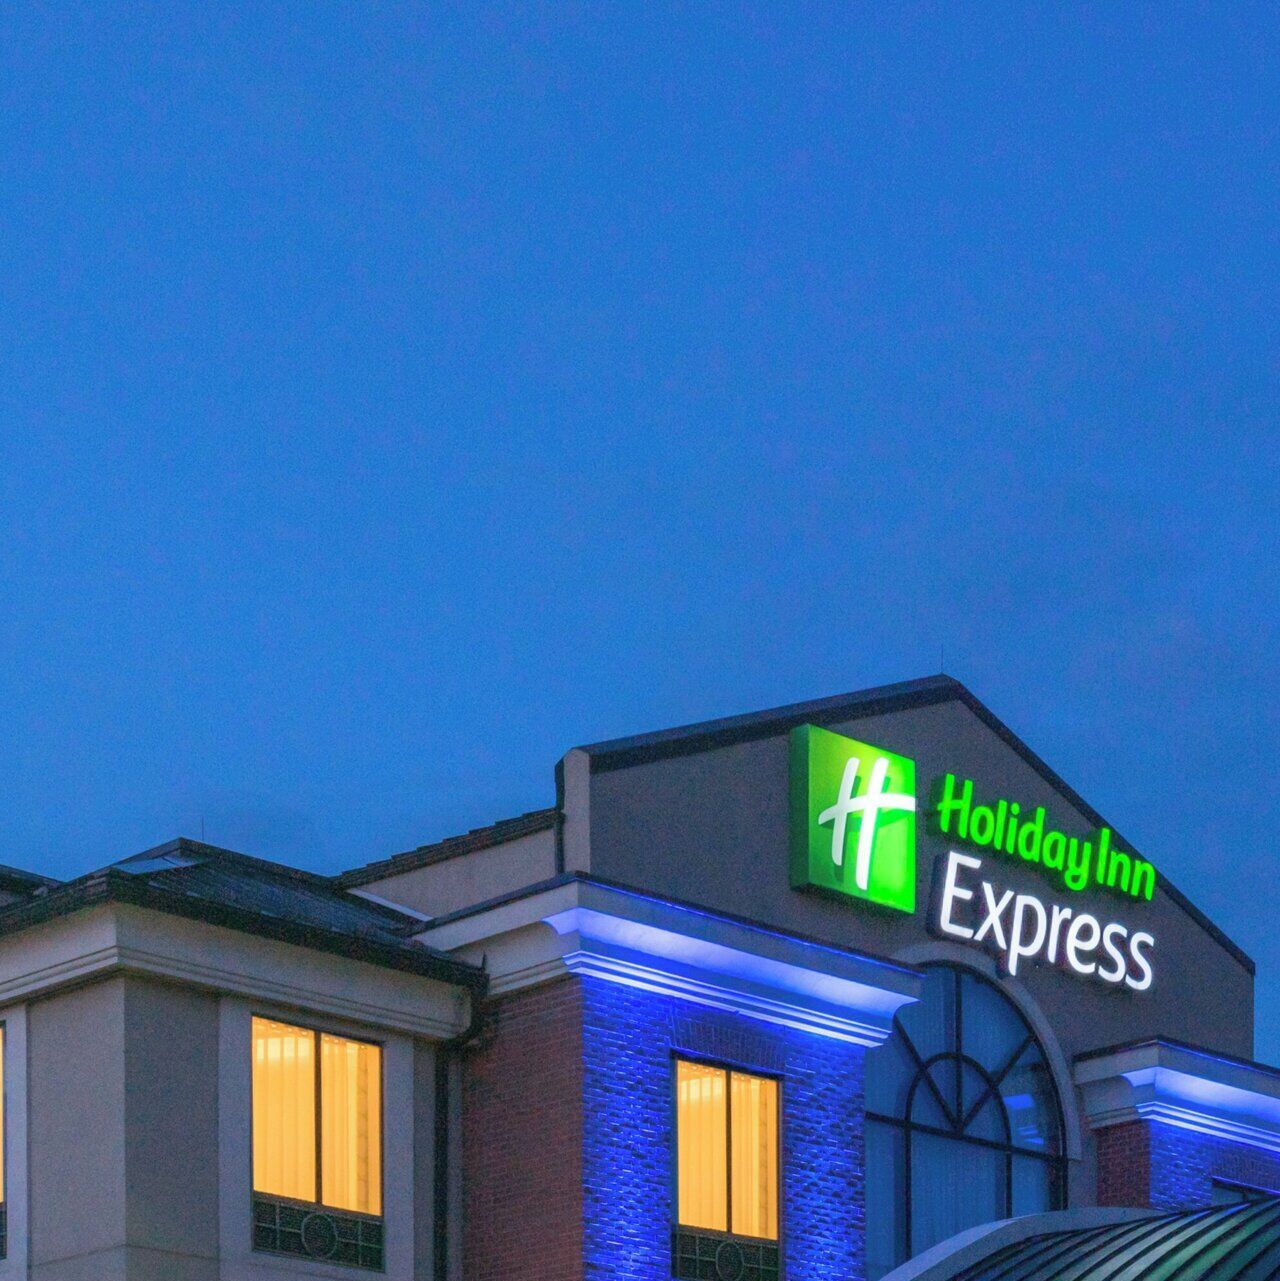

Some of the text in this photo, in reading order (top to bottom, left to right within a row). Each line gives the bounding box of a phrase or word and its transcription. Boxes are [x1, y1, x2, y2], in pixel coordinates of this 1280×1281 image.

[937, 773, 1156, 900] Holiday Inn
[940, 850, 1155, 991] Express
